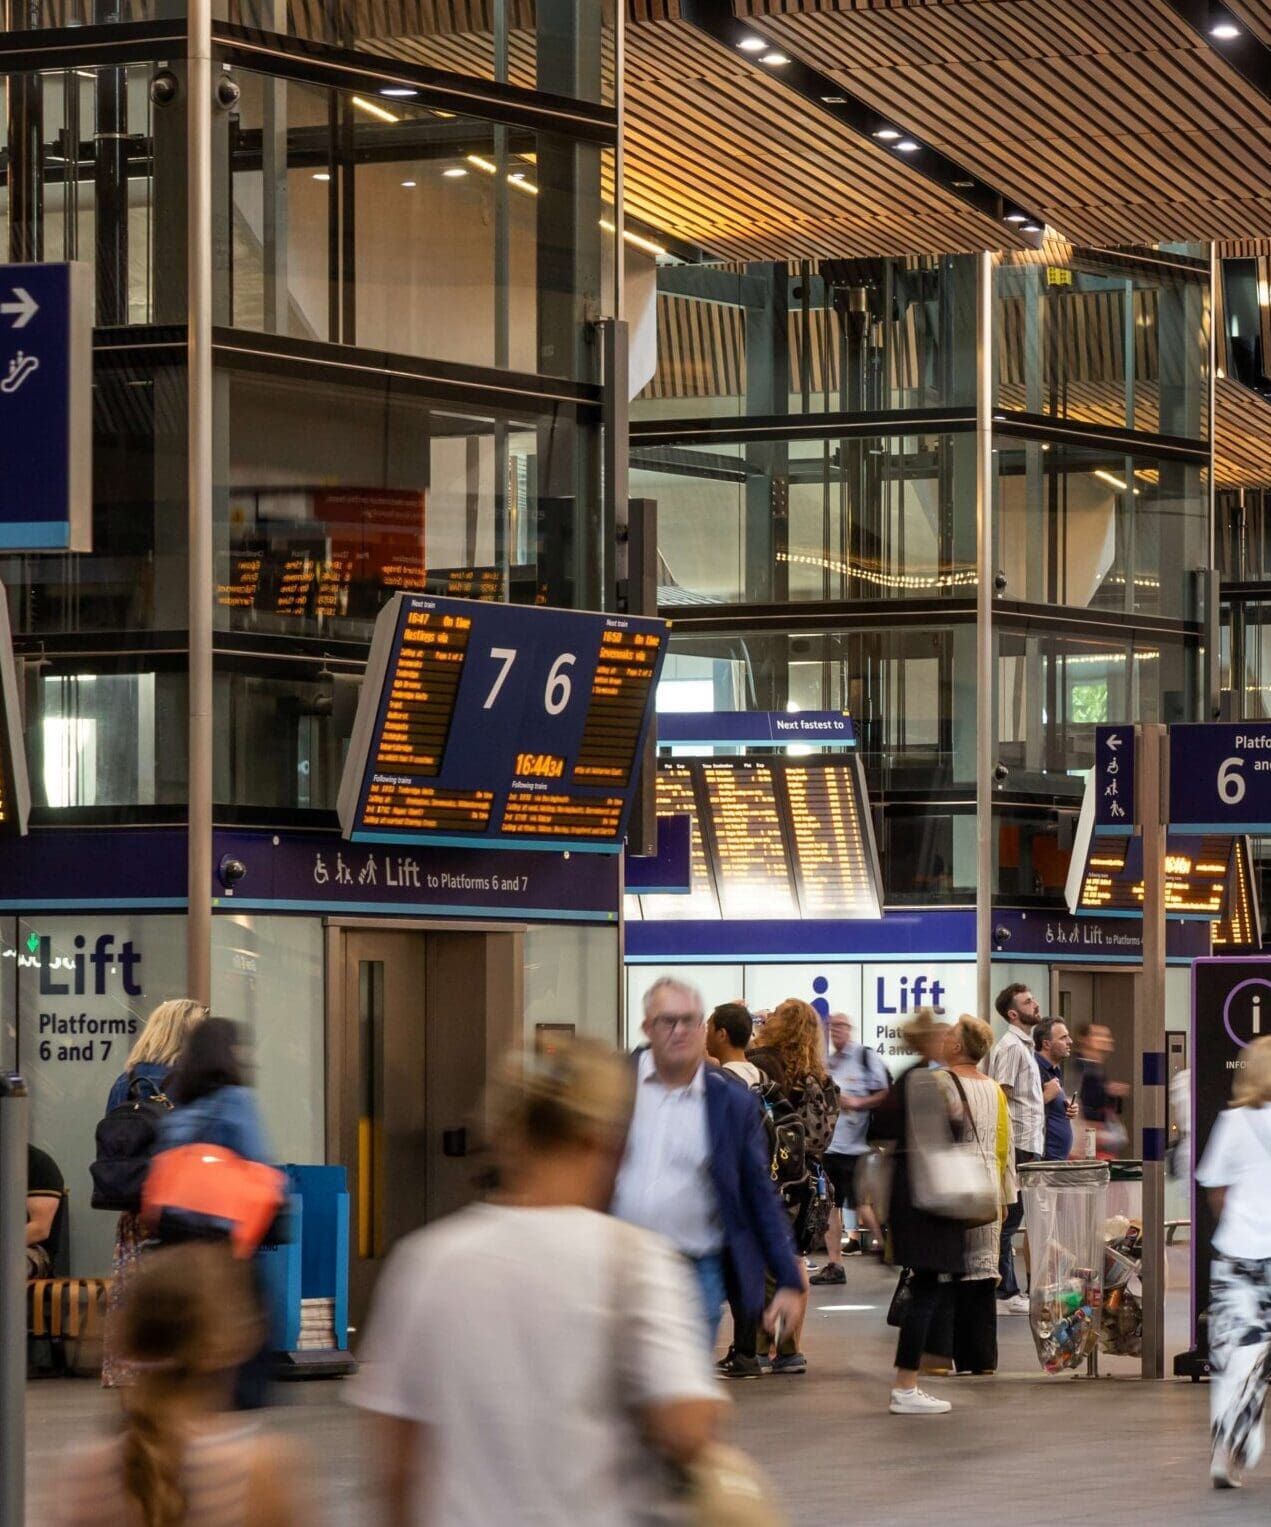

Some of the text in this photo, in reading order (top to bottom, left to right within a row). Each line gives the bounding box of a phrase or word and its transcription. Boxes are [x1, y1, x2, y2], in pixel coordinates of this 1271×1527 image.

[484, 647, 517, 709] 7
[544, 652, 577, 715] 6
[777, 719, 845, 731] Next fastest to
[1217, 757, 1246, 805] 6
[385, 857, 528, 892] Lift to Platforms 6 and 7
[1084, 925, 1140, 946] Lift to Platforms
[39, 934, 143, 996] Lift
[877, 975, 945, 1015] Lift
[39, 1013, 138, 1035] Platforms
[39, 1040, 113, 1062] 6 and 7
[876, 1042, 885, 1056] 4
